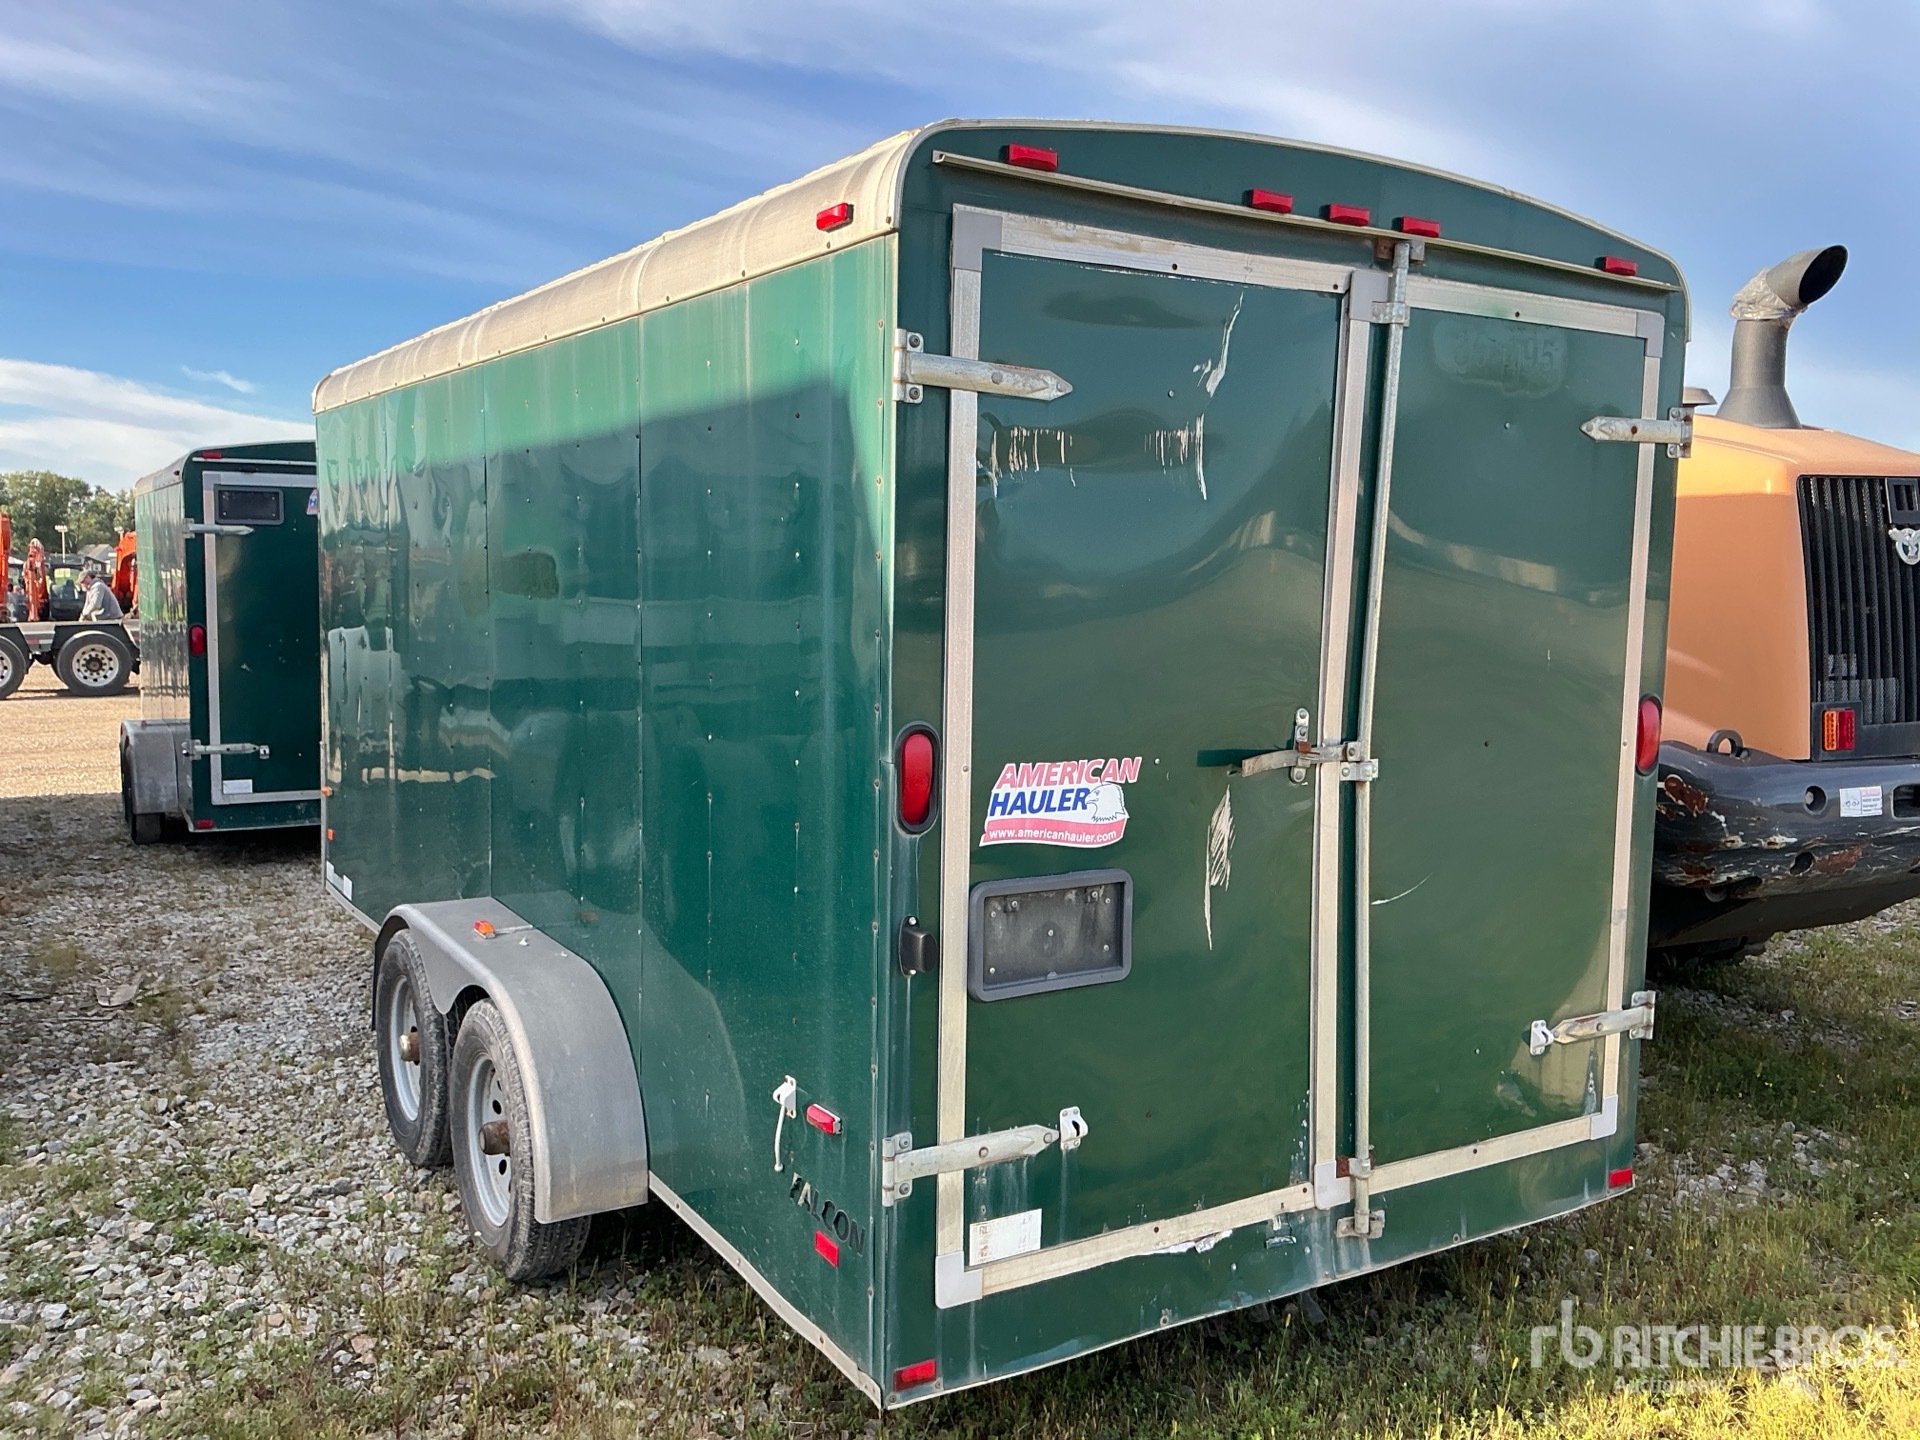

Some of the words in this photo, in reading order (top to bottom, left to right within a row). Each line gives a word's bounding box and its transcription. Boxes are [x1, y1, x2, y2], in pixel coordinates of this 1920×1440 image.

[994, 757, 1142, 790] AMERICAN
[989, 787, 1091, 817] HAULER
[989, 828, 1117, 844] www.americanhauler.com
